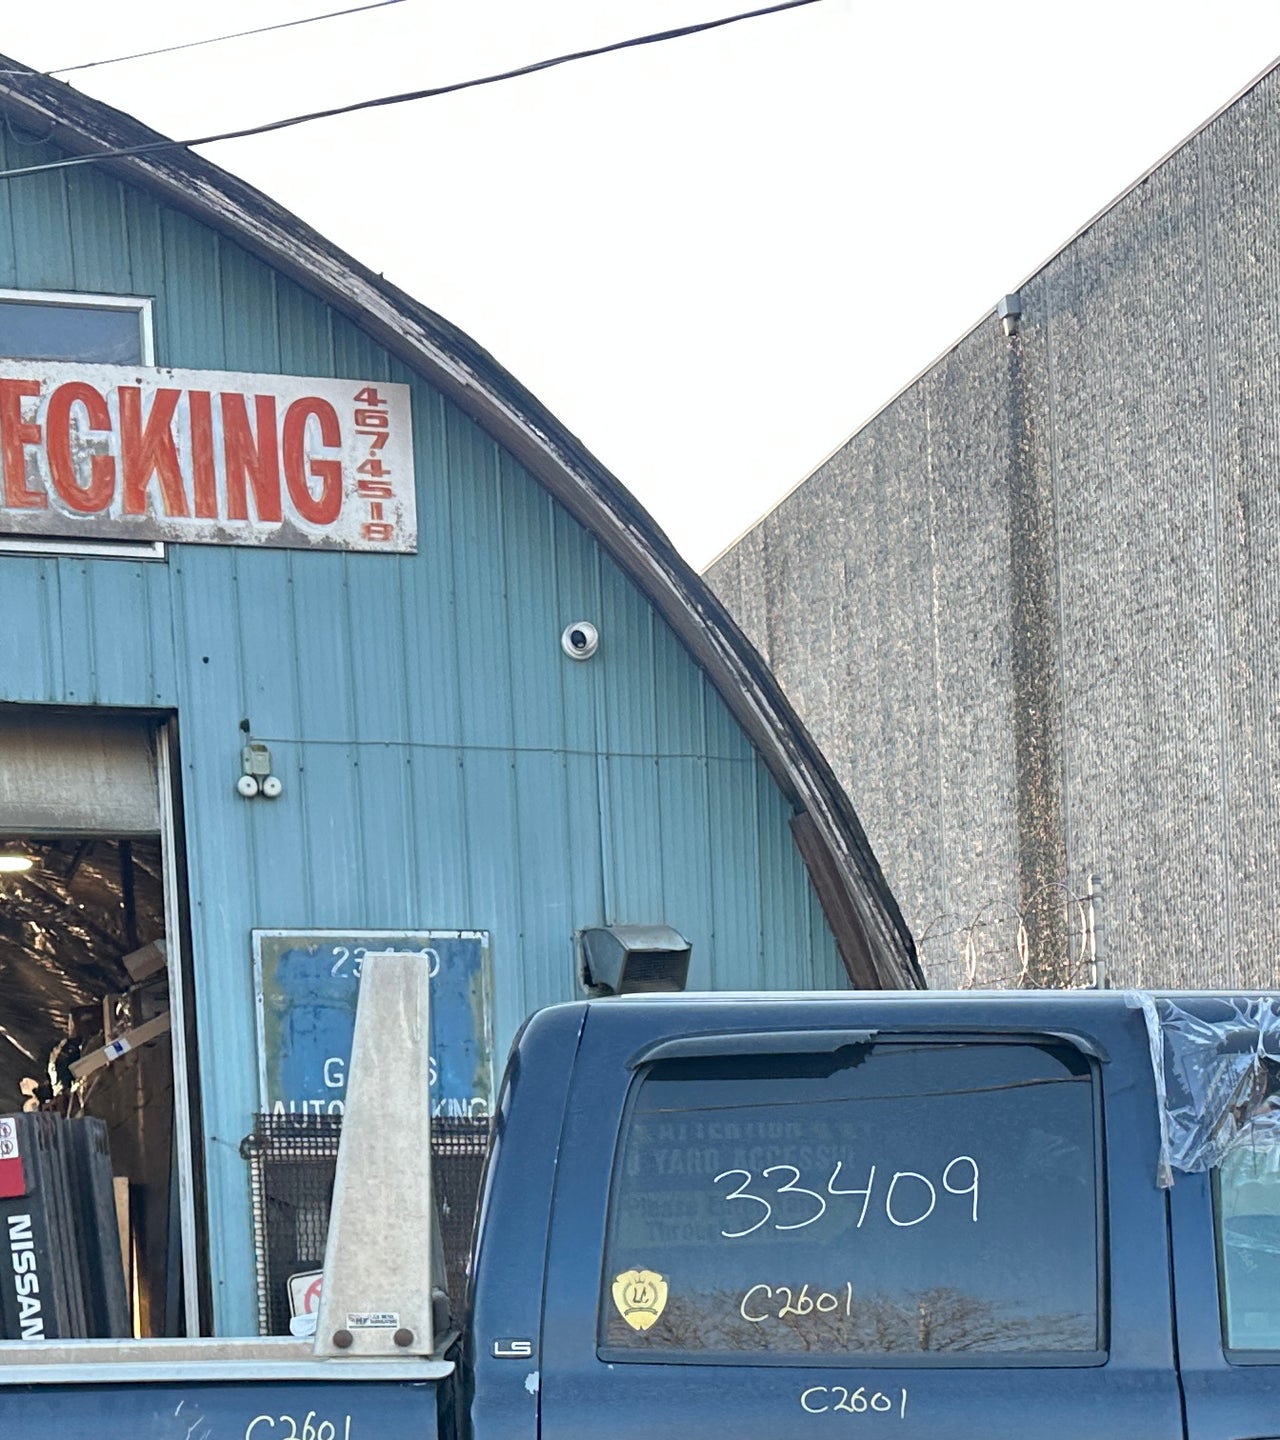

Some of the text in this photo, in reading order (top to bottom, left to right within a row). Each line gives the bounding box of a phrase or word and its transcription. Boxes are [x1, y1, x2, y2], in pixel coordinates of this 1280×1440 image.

[714, 1155, 980, 1238] 33409
[6, 1214, 46, 1341] NISSAN
[740, 1282, 853, 1323] C2601
[494, 1341, 532, 1355] LS
[801, 1386, 908, 1419] C2601
